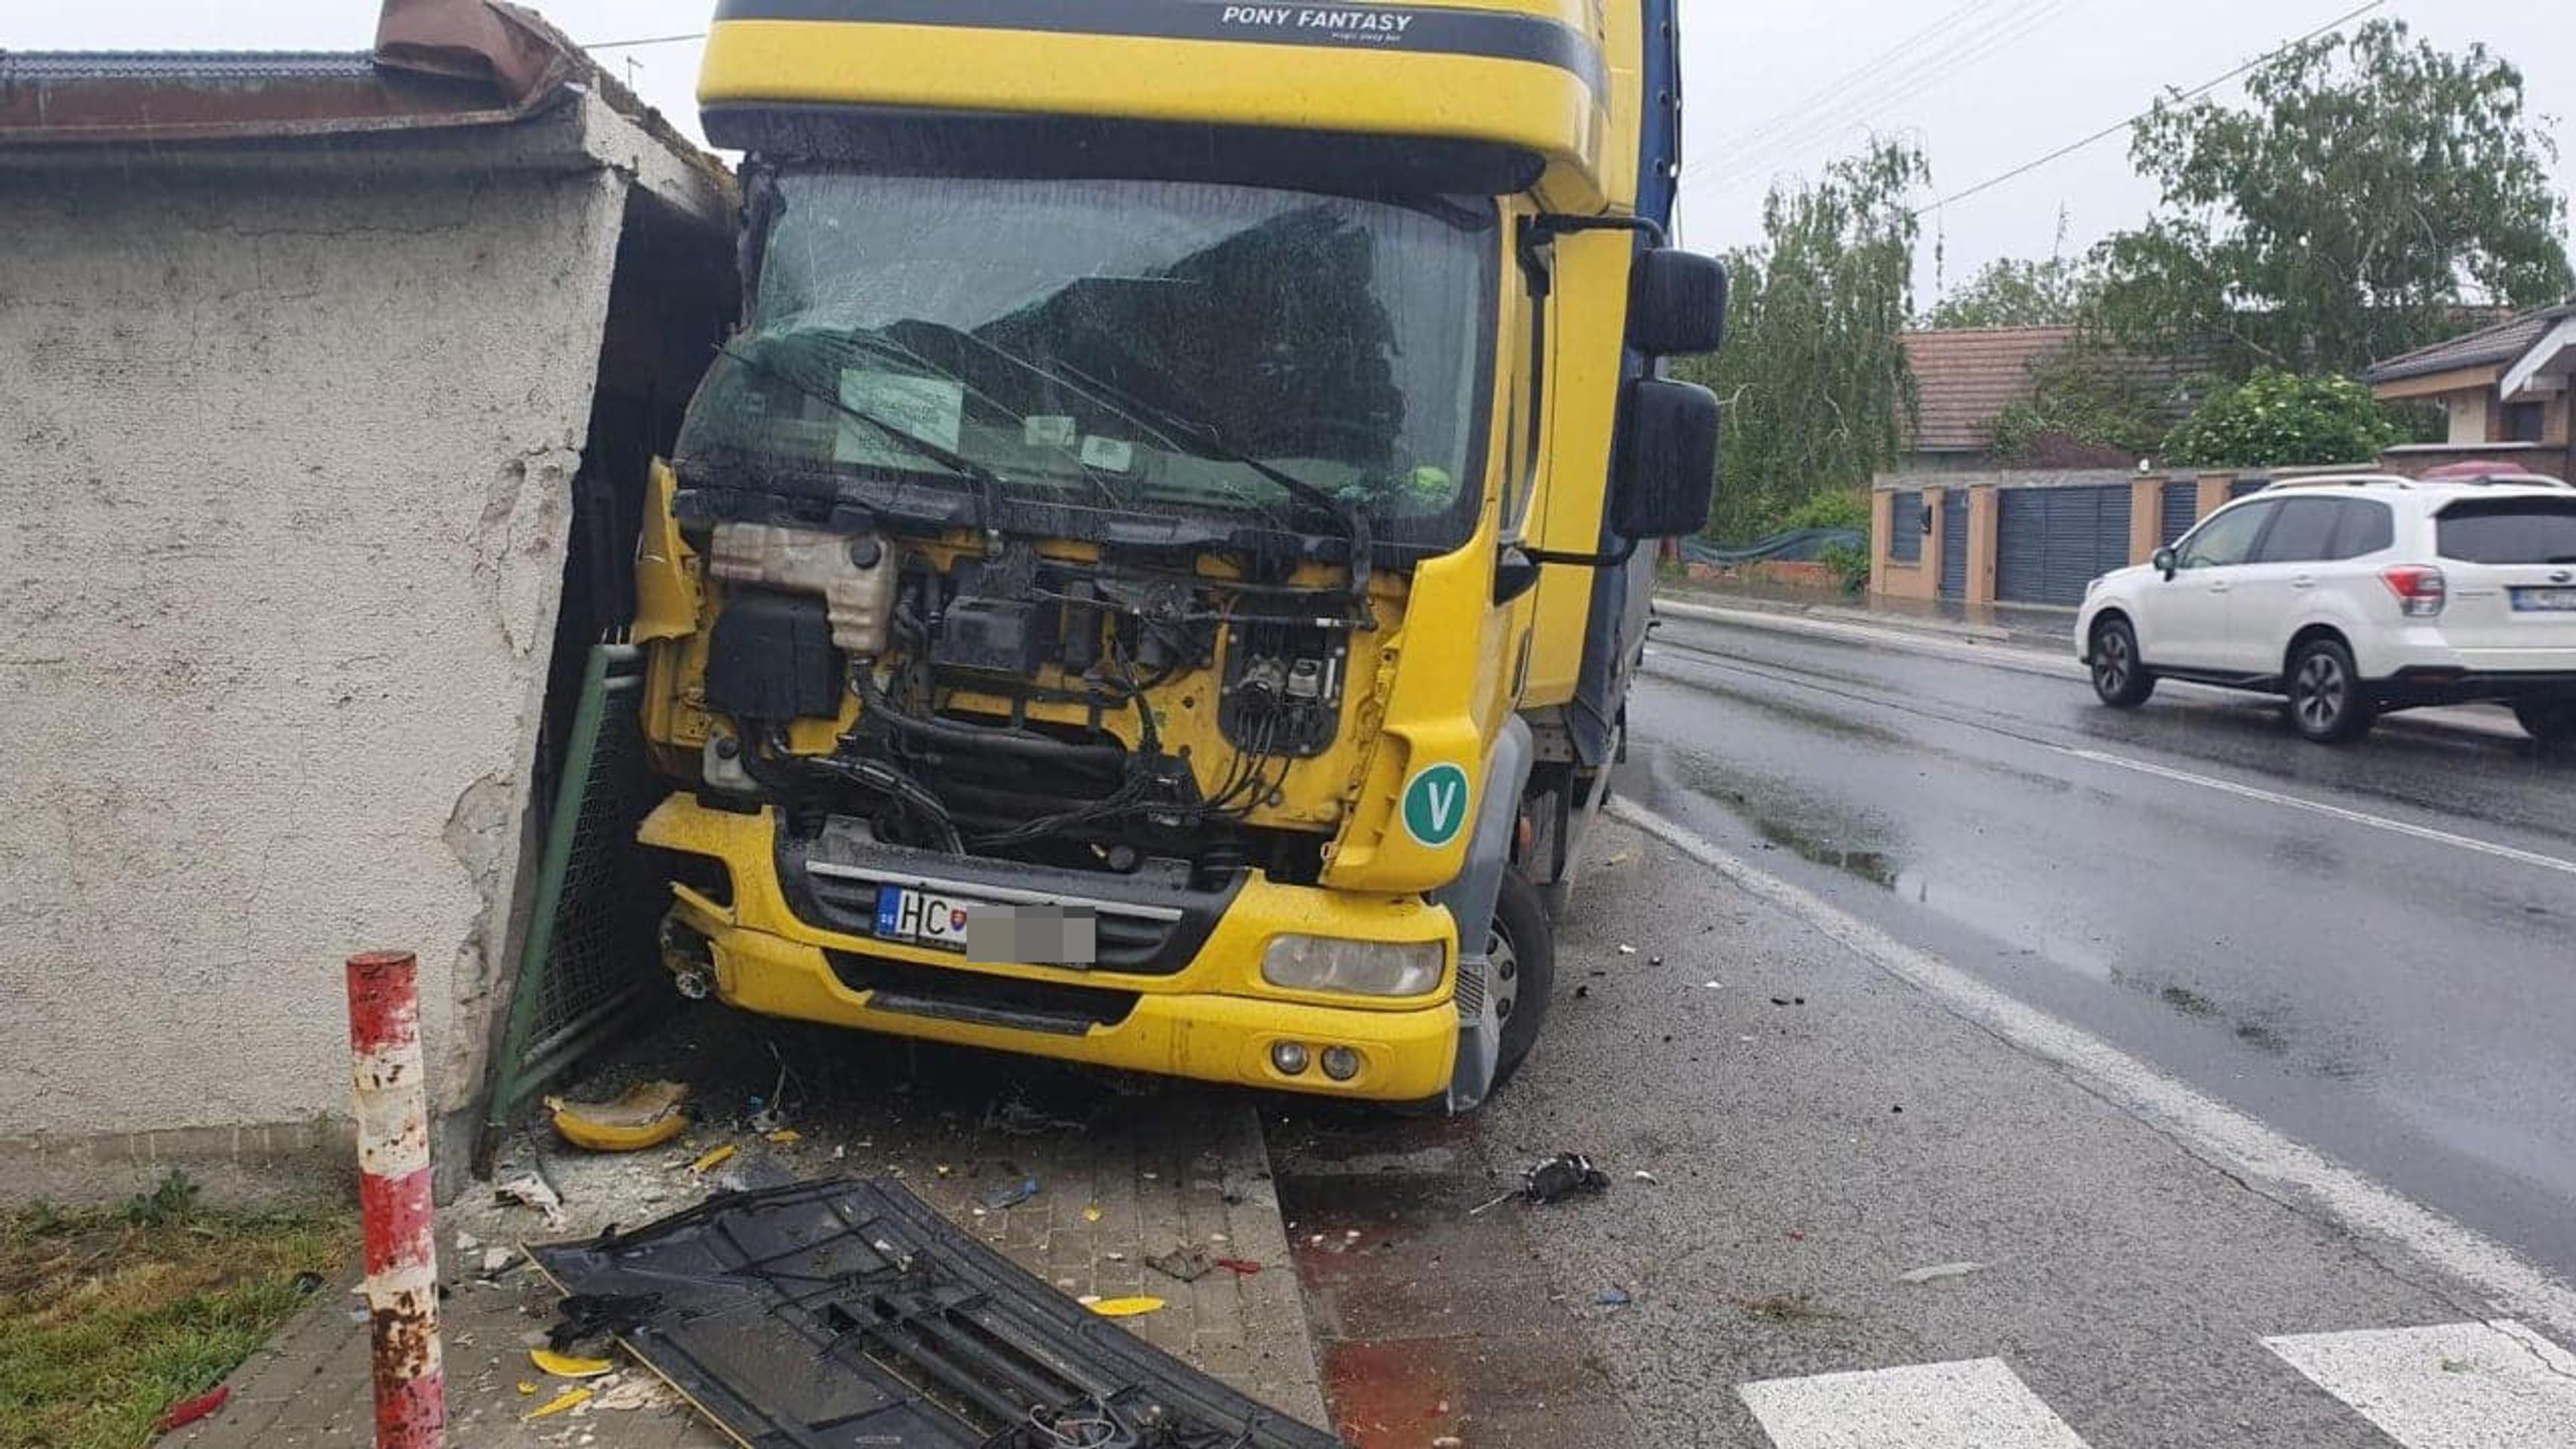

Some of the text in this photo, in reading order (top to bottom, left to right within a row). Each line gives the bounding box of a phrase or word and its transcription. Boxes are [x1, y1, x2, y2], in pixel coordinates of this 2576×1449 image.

[1222, 7, 1411, 31] PONY FANTASY
[1428, 780, 1457, 831] V
[901, 894, 947, 936] HC
